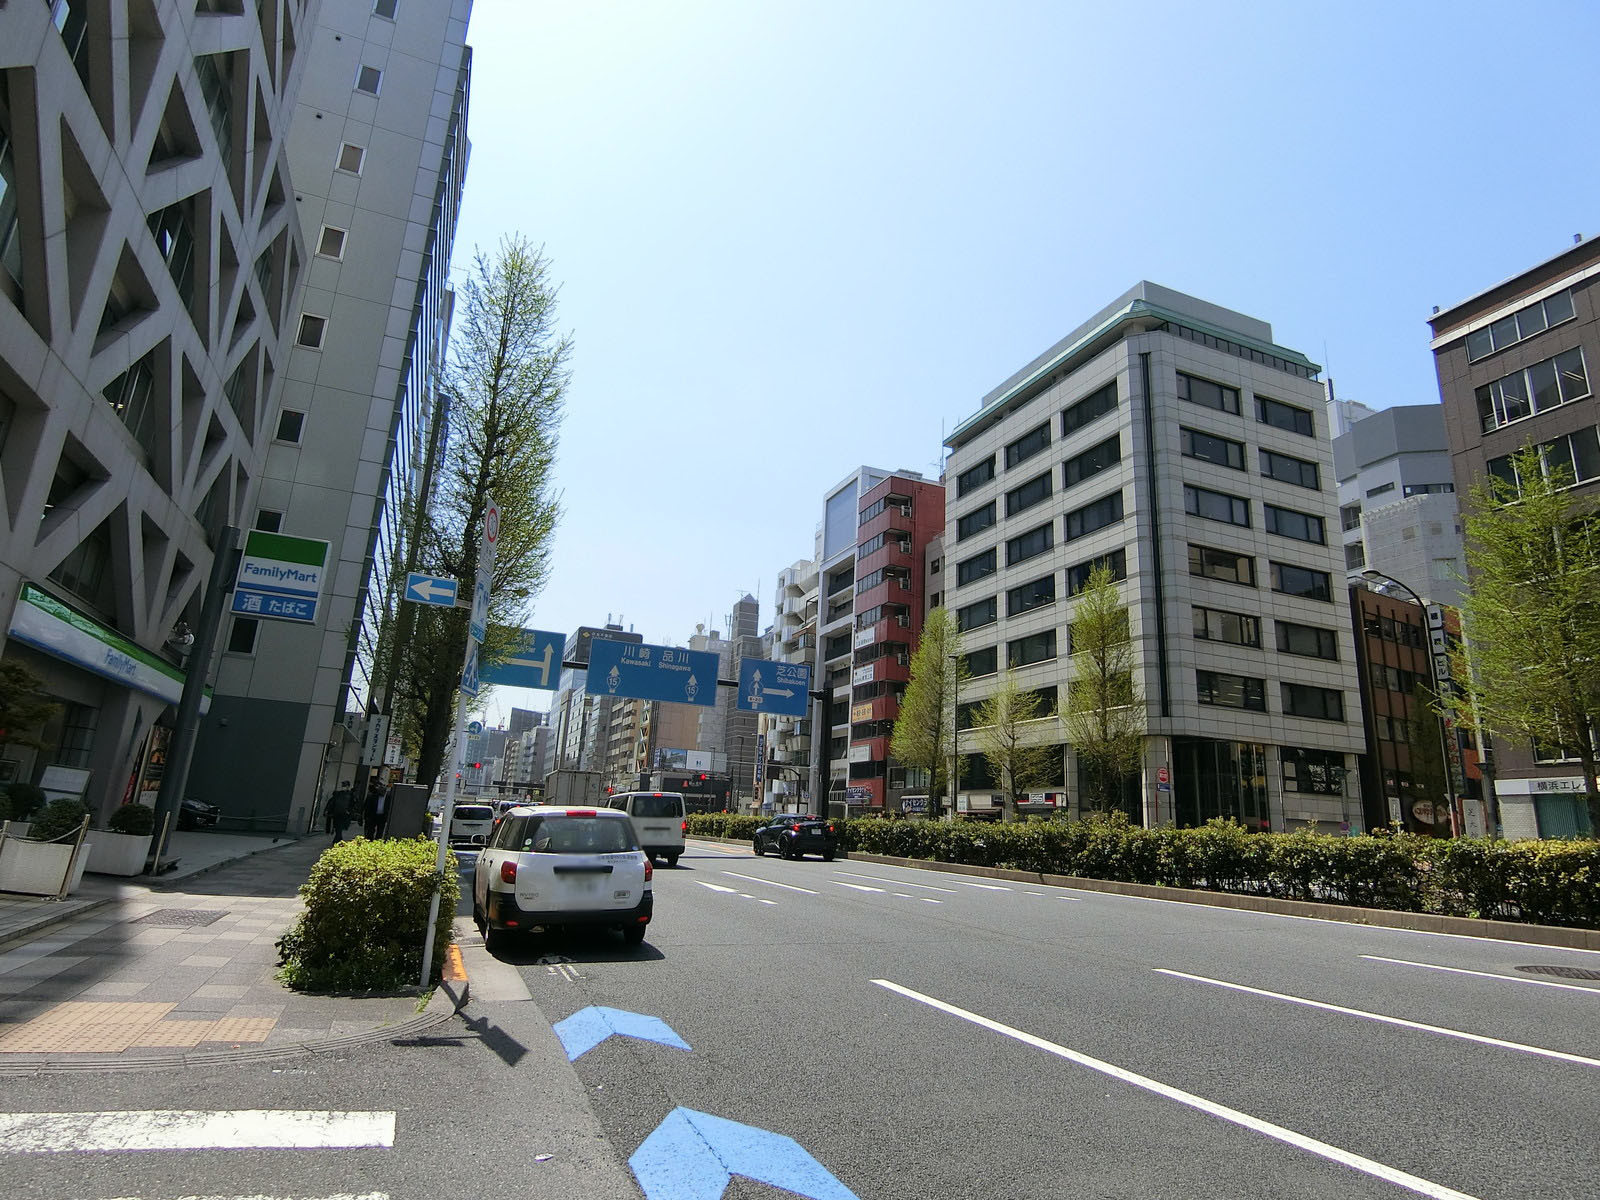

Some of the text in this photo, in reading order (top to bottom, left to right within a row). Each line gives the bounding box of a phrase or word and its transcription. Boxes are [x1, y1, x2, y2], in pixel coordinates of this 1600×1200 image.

[244, 563, 318, 583] FamilyMart
[242, 594, 308, 616] 酒 たばこ
[623, 645, 689, 664] 川崎 品川
[106, 648, 137, 677] FamilyMart
[620, 657, 692, 672] Kawasaki Shinagawa
[776, 665, 808, 680] 芝公園
[608, 678, 618, 687] 15
[687, 686, 696, 695] 15
[1537, 781, 1586, 791] 横浜エレ
